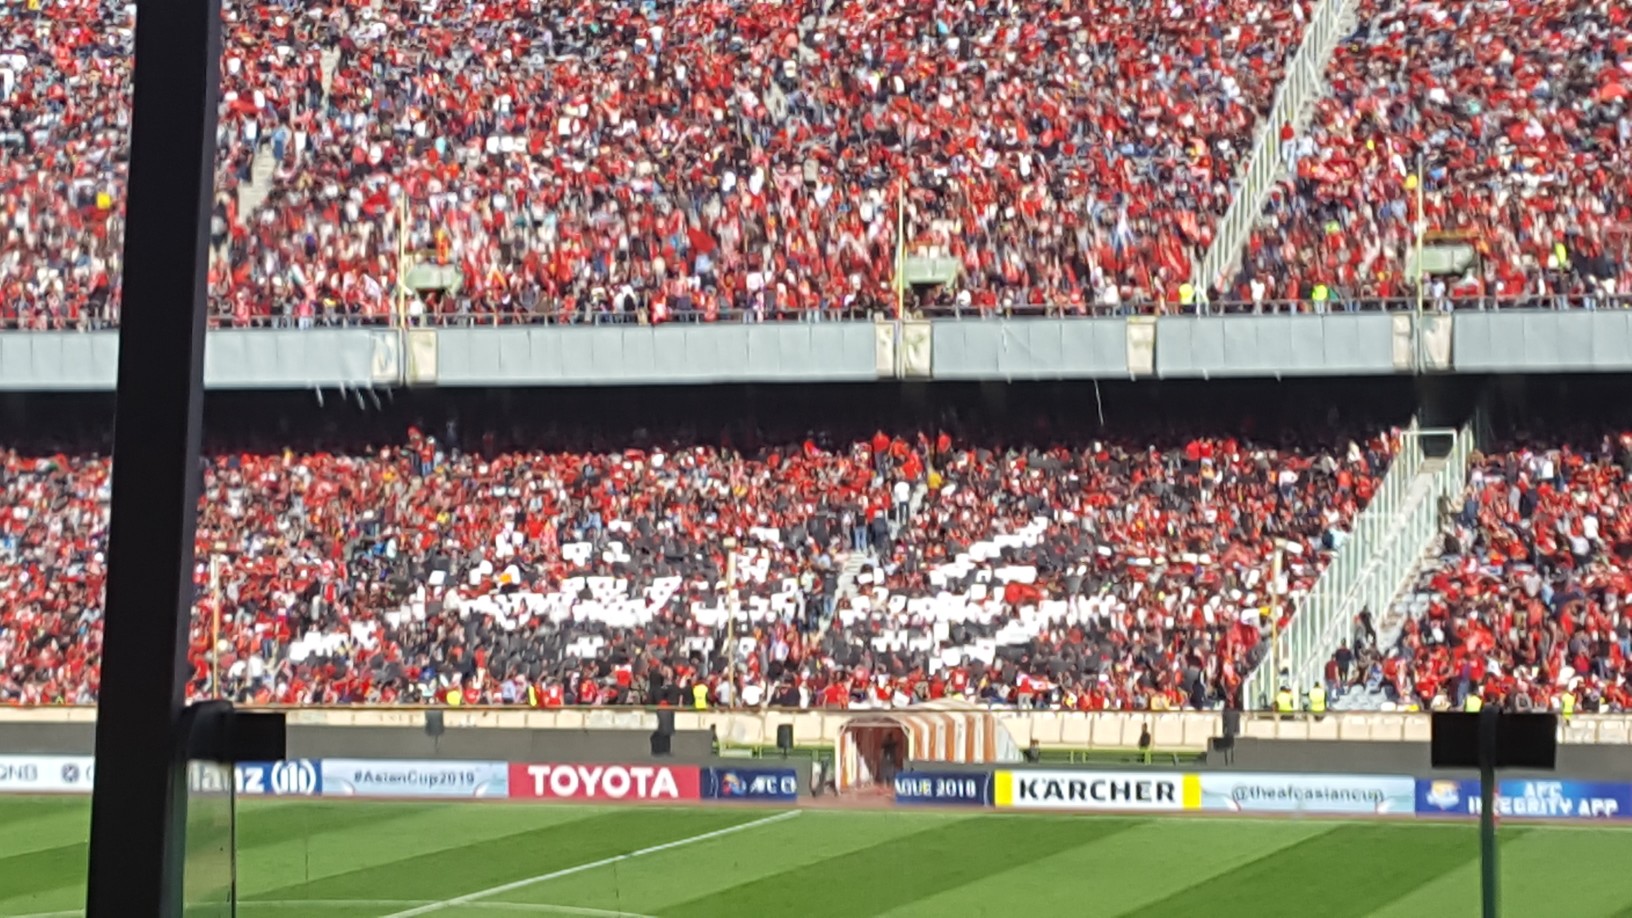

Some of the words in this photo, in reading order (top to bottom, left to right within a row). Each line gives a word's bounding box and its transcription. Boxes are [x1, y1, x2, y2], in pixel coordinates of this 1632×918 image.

[354, 770, 475, 788] #AsianCup2019
[528, 764, 679, 798] TOYOTA
[1019, 777, 1176, 802] KÄRCHER
[1524, 781, 1563, 798] AFC
[1231, 782, 1384, 806] @theafcasiancup
[1578, 797, 1619, 817] APP
